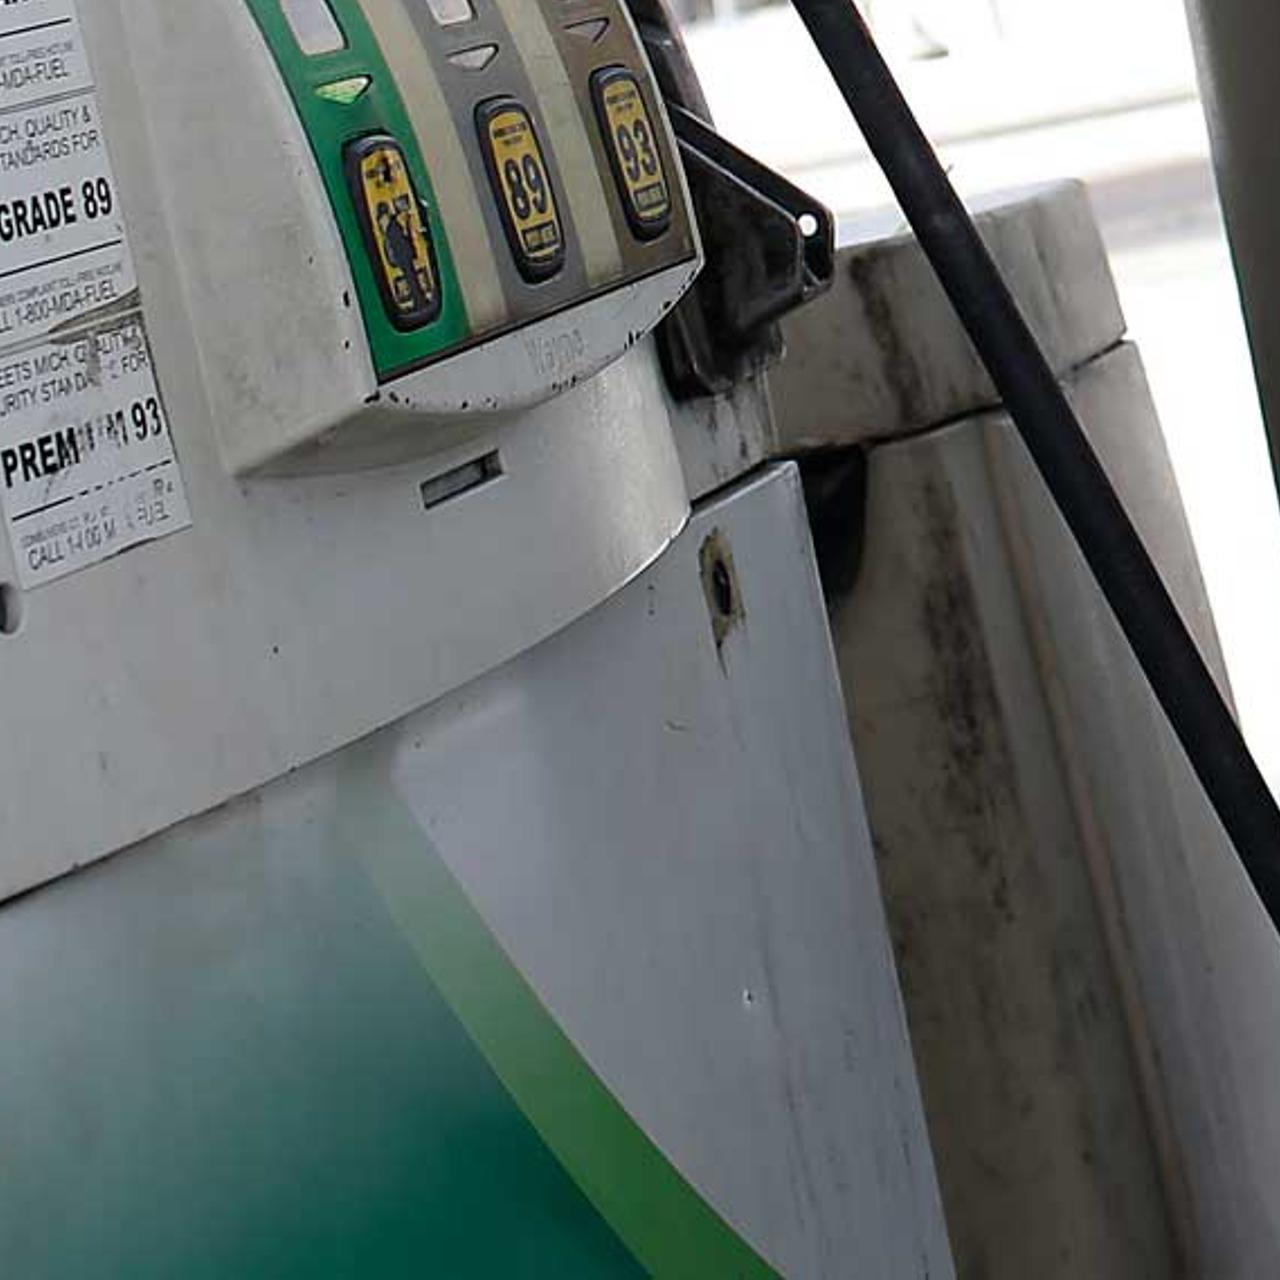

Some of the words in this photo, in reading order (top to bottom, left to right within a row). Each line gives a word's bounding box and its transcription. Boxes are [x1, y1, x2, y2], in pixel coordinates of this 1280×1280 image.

[25, 107, 79, 138] QUALITY
[71, 129, 100, 153] FOR
[616, 118, 658, 182] 93
[504, 153, 547, 220] 89
[0, 186, 78, 242] GRADE
[82, 177, 113, 220] 89
[121, 349, 149, 374] FOR
[130, 396, 163, 441] 93
[28, 539, 65, 571] CALL
